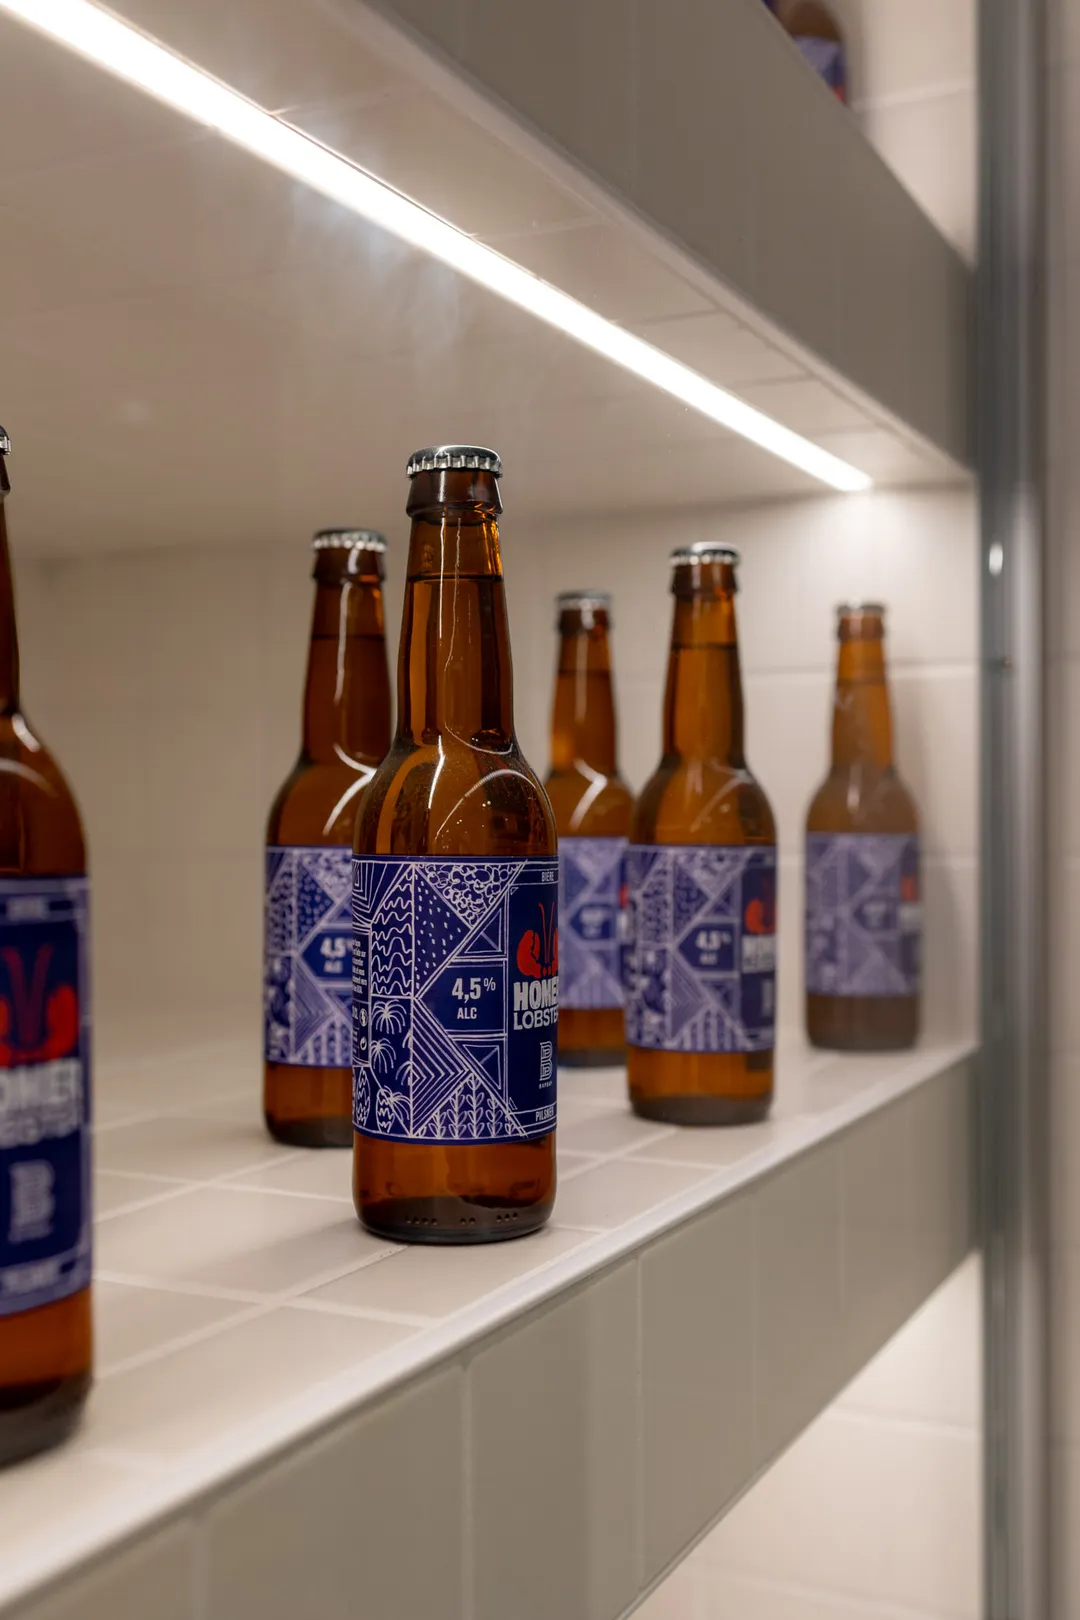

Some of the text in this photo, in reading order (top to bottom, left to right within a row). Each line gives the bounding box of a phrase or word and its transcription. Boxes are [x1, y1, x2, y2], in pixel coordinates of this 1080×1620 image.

[451, 977, 496, 1003] 4,5%
[513, 976, 558, 1011] HOME
[457, 1007, 477, 1020] ALC
[513, 1007, 558, 1030] LOBSTE
